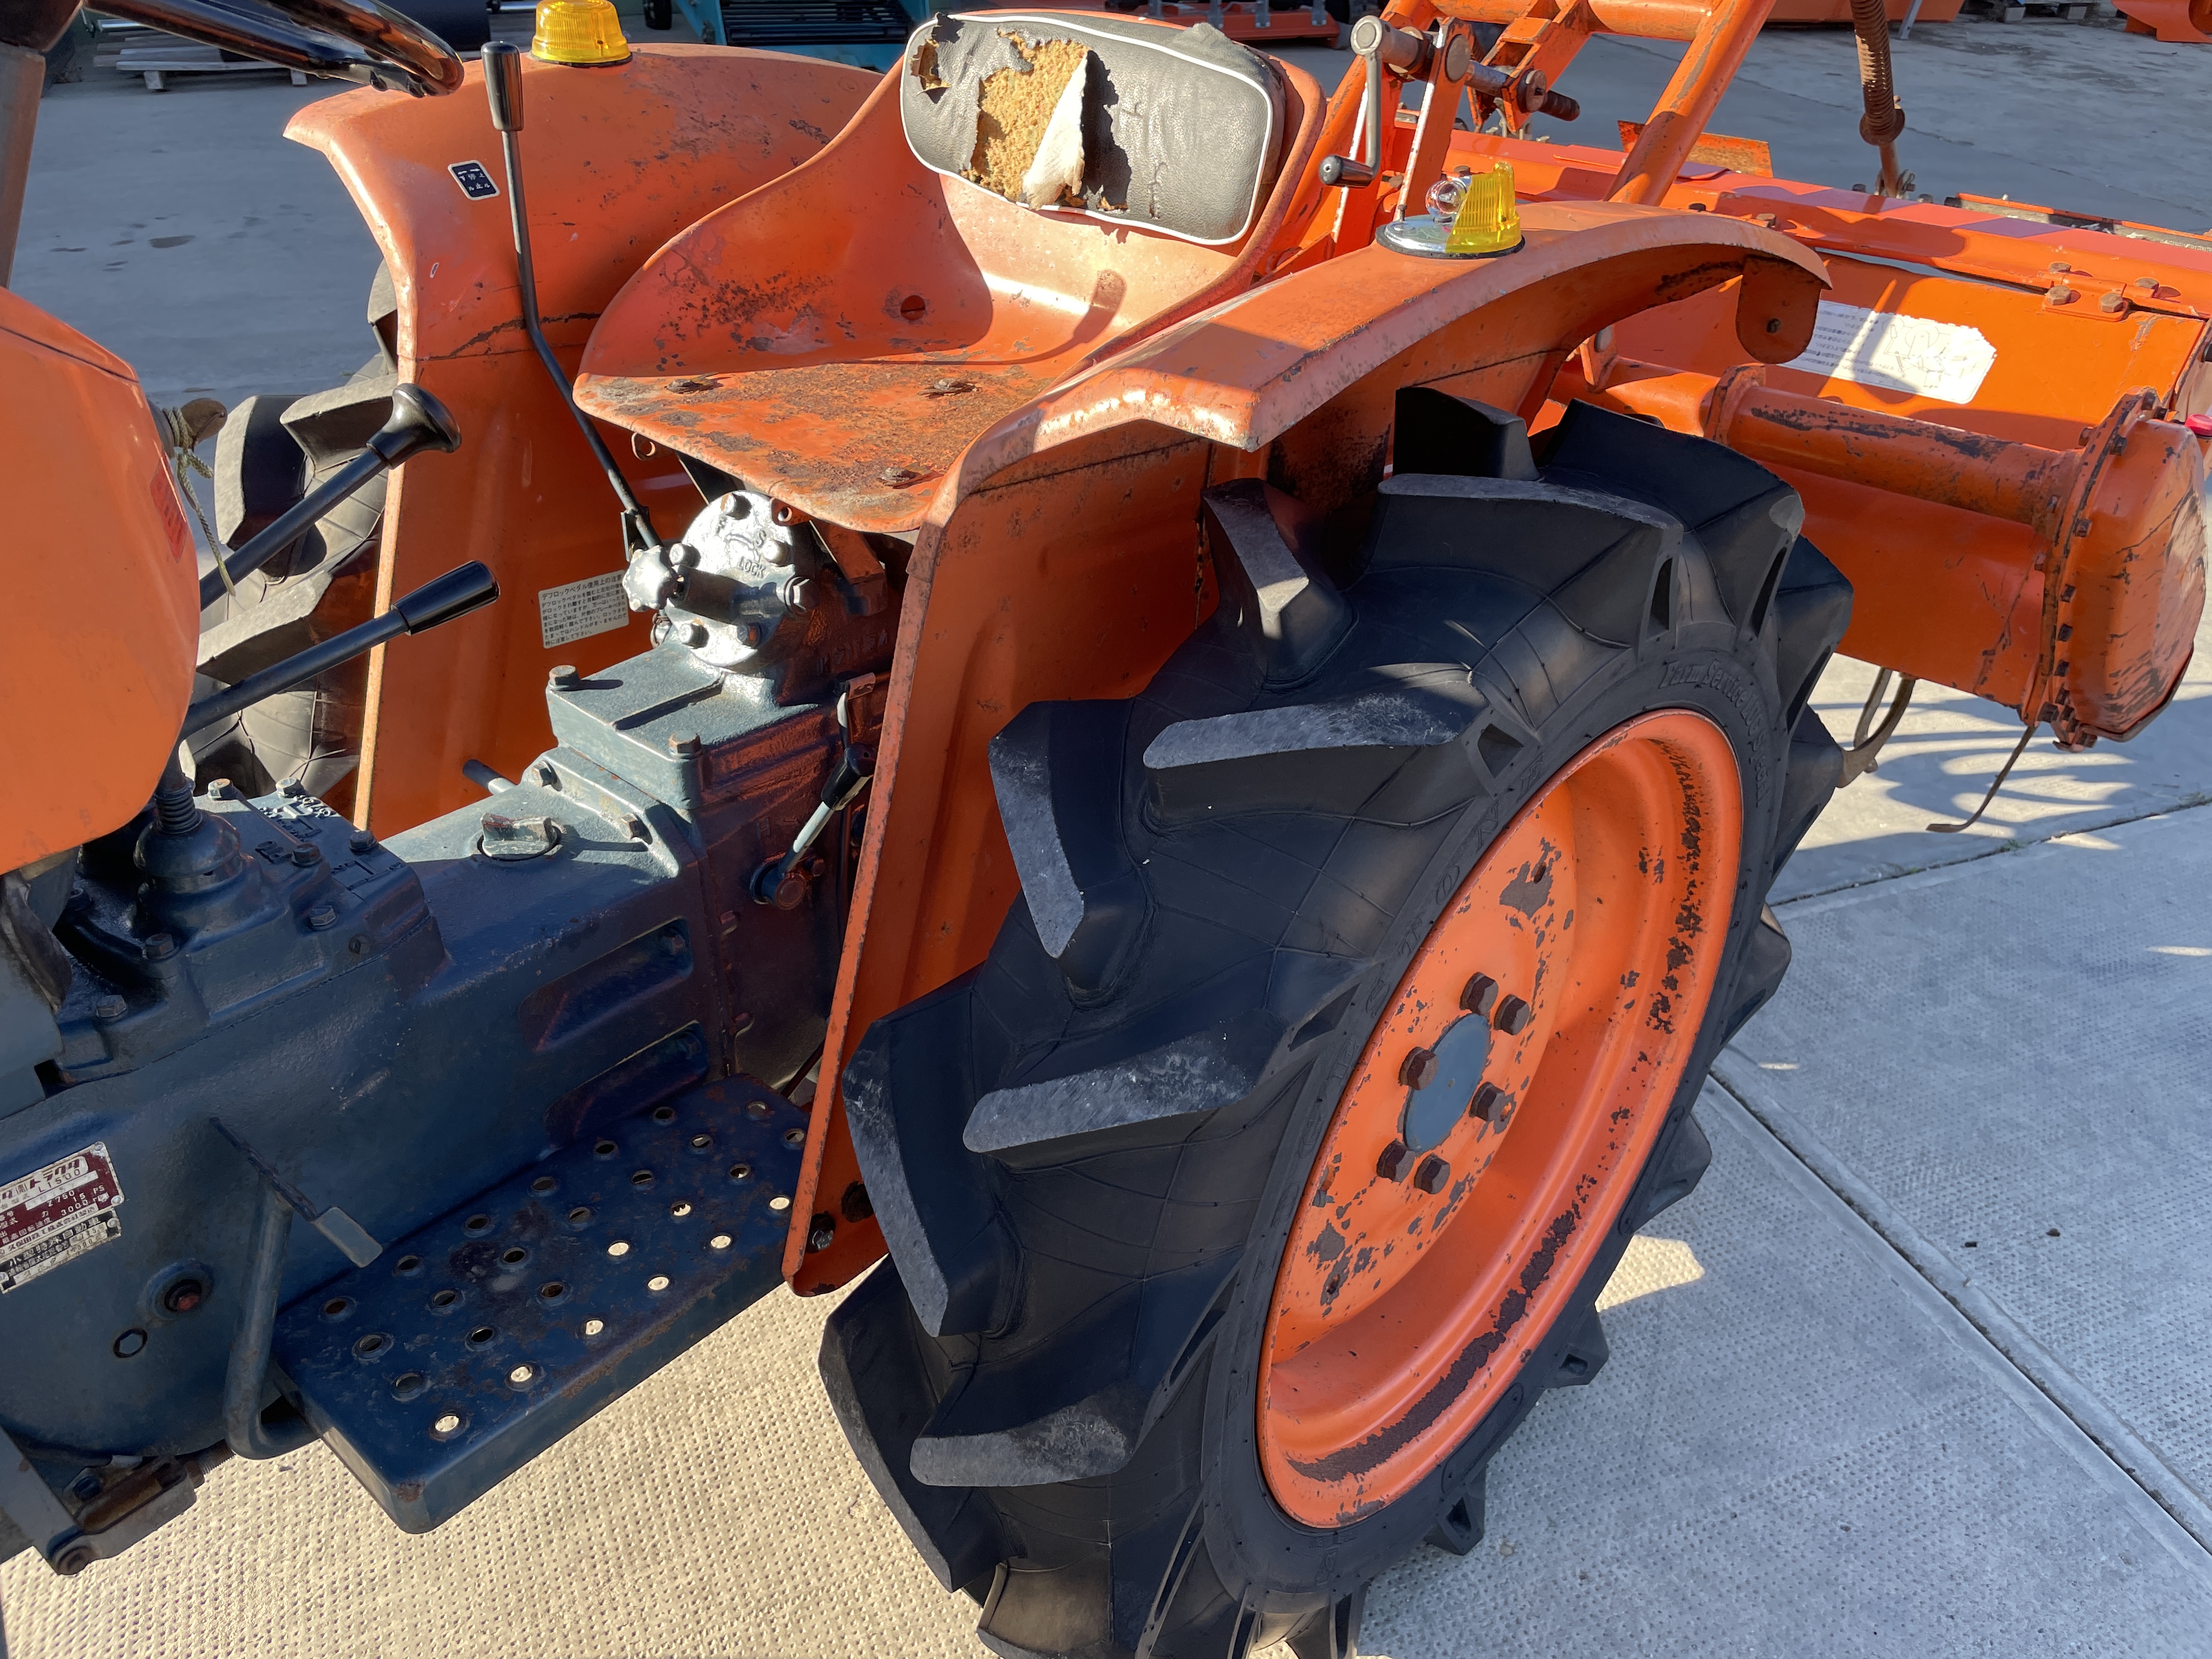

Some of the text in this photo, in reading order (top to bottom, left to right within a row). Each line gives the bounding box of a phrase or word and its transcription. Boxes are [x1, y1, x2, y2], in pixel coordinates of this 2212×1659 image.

[738, 557, 768, 579] LOCK
[1658, 660, 1703, 689] Farm
[1706, 659, 1747, 708] Service
[47, 1189, 75, 1207] Z750
[74, 1193, 86, 1203] 15
[93, 1184, 105, 1194] PS
[61, 1199, 88, 1216] 3000
